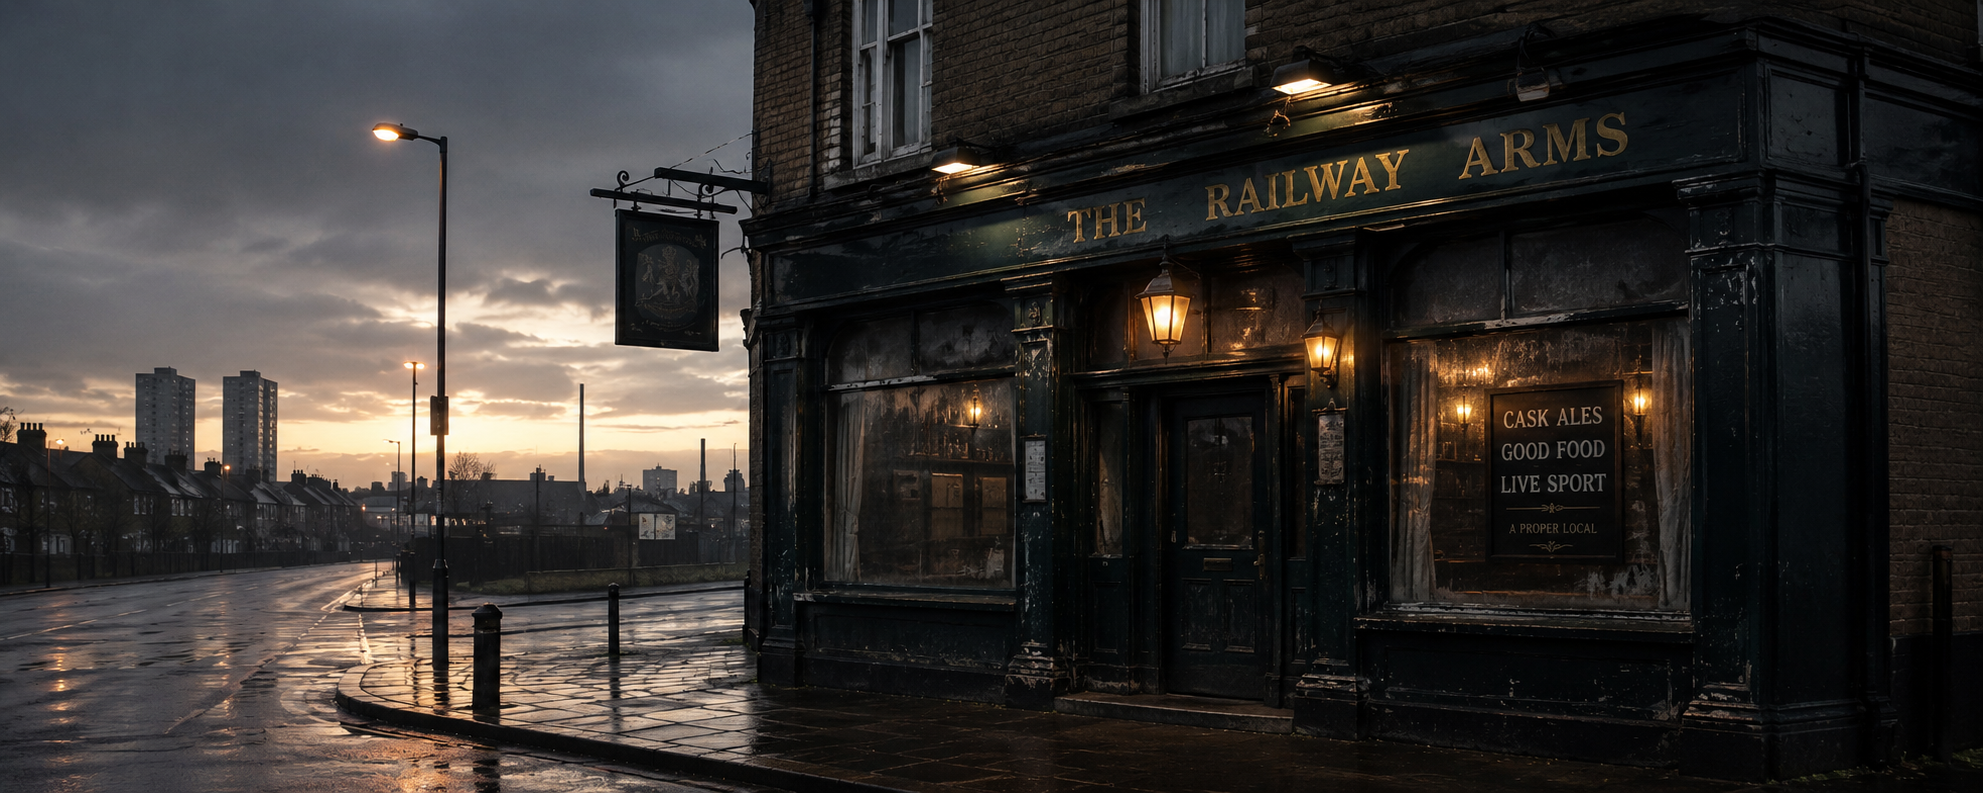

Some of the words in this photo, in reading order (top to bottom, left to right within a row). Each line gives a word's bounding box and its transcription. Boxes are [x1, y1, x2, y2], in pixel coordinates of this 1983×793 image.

[1067, 198, 1147, 244] THE
[1205, 149, 1410, 222] RAILWAY
[1459, 111, 1629, 180] ARMS
[1503, 408, 1549, 429] CASK
[1556, 406, 1603, 427] ALES
[1501, 441, 1550, 461] GOOD
[1556, 439, 1606, 459] FOOD
[1501, 475, 1541, 493] LIVE
[1547, 473, 1607, 493] SPORT
[1509, 524, 1516, 534] A
[1520, 523, 1559, 534] PROPER
[1563, 523, 1597, 534] LOCAL
